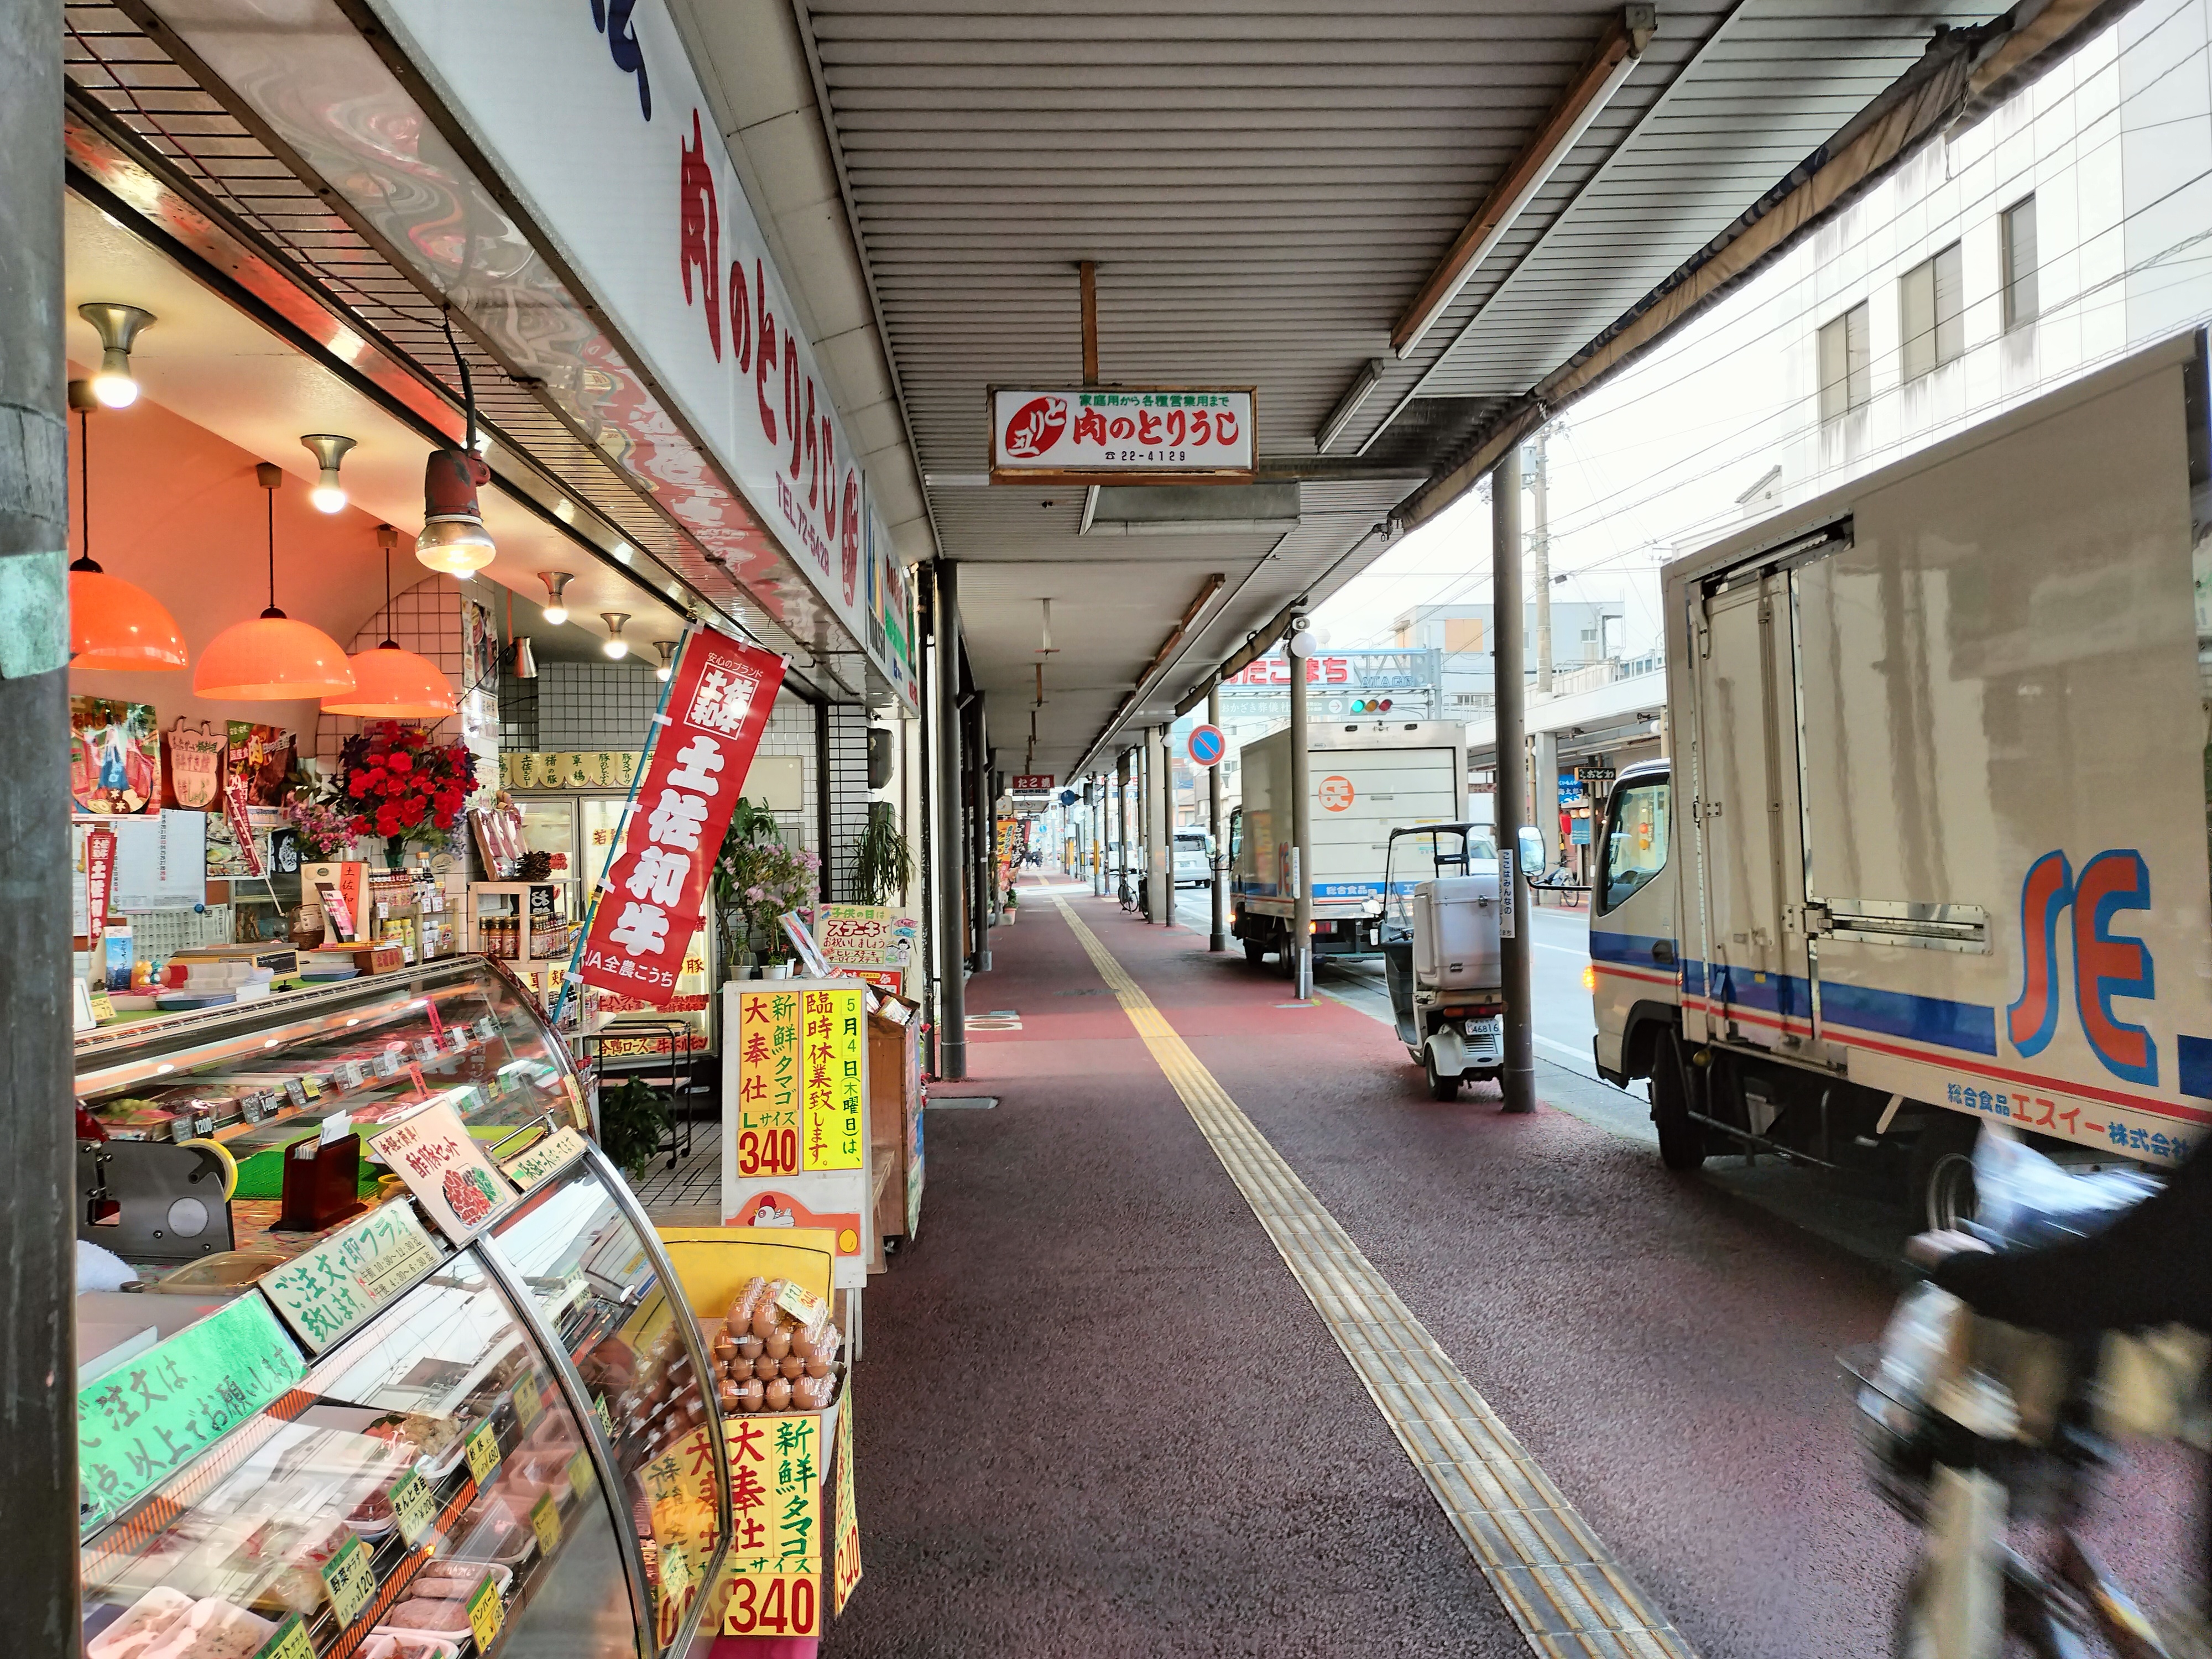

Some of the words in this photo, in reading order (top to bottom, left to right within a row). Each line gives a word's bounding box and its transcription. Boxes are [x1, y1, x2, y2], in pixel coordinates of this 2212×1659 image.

[681, 108, 836, 541] 肉のとりうじ
[1079, 395, 1229, 407] 家庭用から各種営業用まで
[1073, 408, 1239, 446] 肉のとりうじ
[1121, 451, 1186, 461] 22-4129
[776, 471, 797, 529] TEL
[797, 502, 830, 577] 72-5428
[707, 652, 764, 678] 安心のブランド
[1221, 701, 1291, 714] おかざき葬儀社
[610, 734, 724, 956] 土佐和牛
[1326, 885, 1367, 895] 総合食品
[1503, 852, 1512, 915] ここはみんなの
[827, 920, 890, 937] ステーキで
[832, 907, 885, 919] 子供の日は
[823, 937, 885, 948] お祝いしましょう
[585, 950, 674, 987] JA全農こうち
[741, 997, 771, 1104] 大奉仕
[771, 994, 799, 1105] 新鮮タマゴ
[806, 991, 836, 1167] 臨時休業致します。
[744, 1112, 795, 1129] Lサイズ
[739, 1129, 795, 1176] 340
[274, 1209, 411, 1310] ご注文で即フライ
[359, 1267, 374, 1283] 午前
[300, 1288, 366, 1343] 致します。
[395, 1473, 428, 1517] きんとき豆
[730, 1421, 766, 1554] 大奉仕
[774, 1420, 818, 1558] 新鮮タマゴ
[330, 1551, 362, 1595] 野菜サラダ
[838, 1525, 859, 1604] 340
[471, 1584, 496, 1627] ハンバーグ
[729, 1578, 814, 1635] 340
